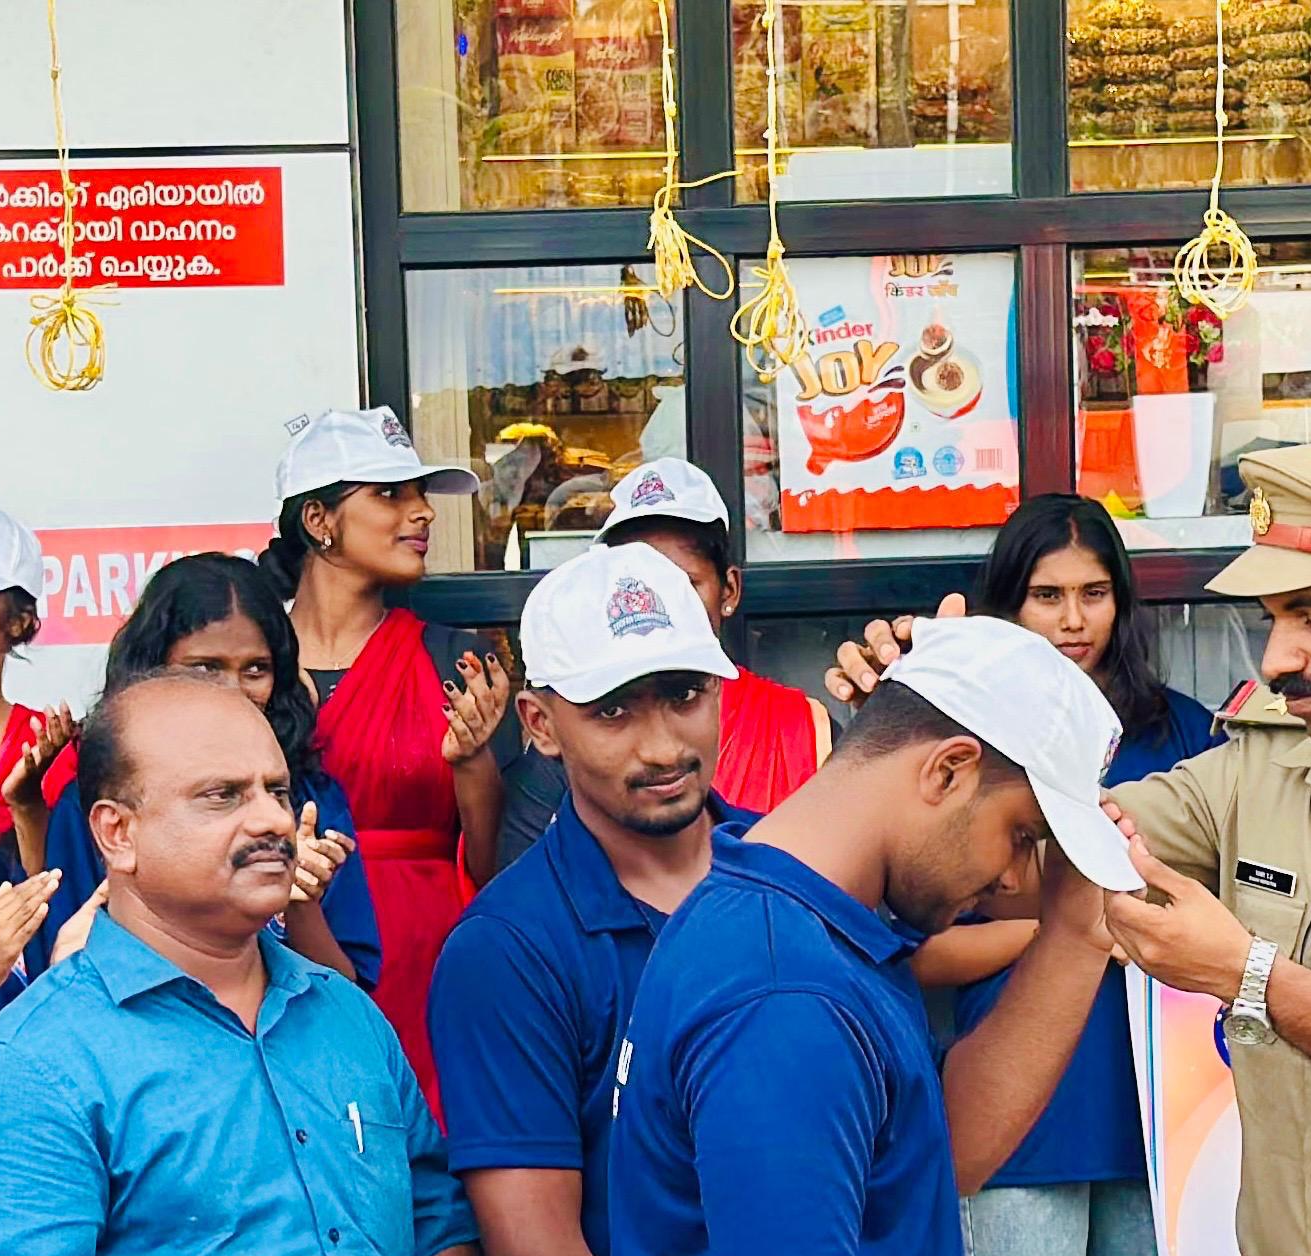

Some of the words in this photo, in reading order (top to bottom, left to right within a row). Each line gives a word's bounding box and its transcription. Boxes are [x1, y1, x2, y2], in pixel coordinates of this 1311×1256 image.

[96, 180, 265, 210] ഏരിയായിൽ
[130, 219, 235, 242] വാഹനം
[100, 254, 221, 281] ചെയ്യുക.
[790, 339, 900, 402] JOY
